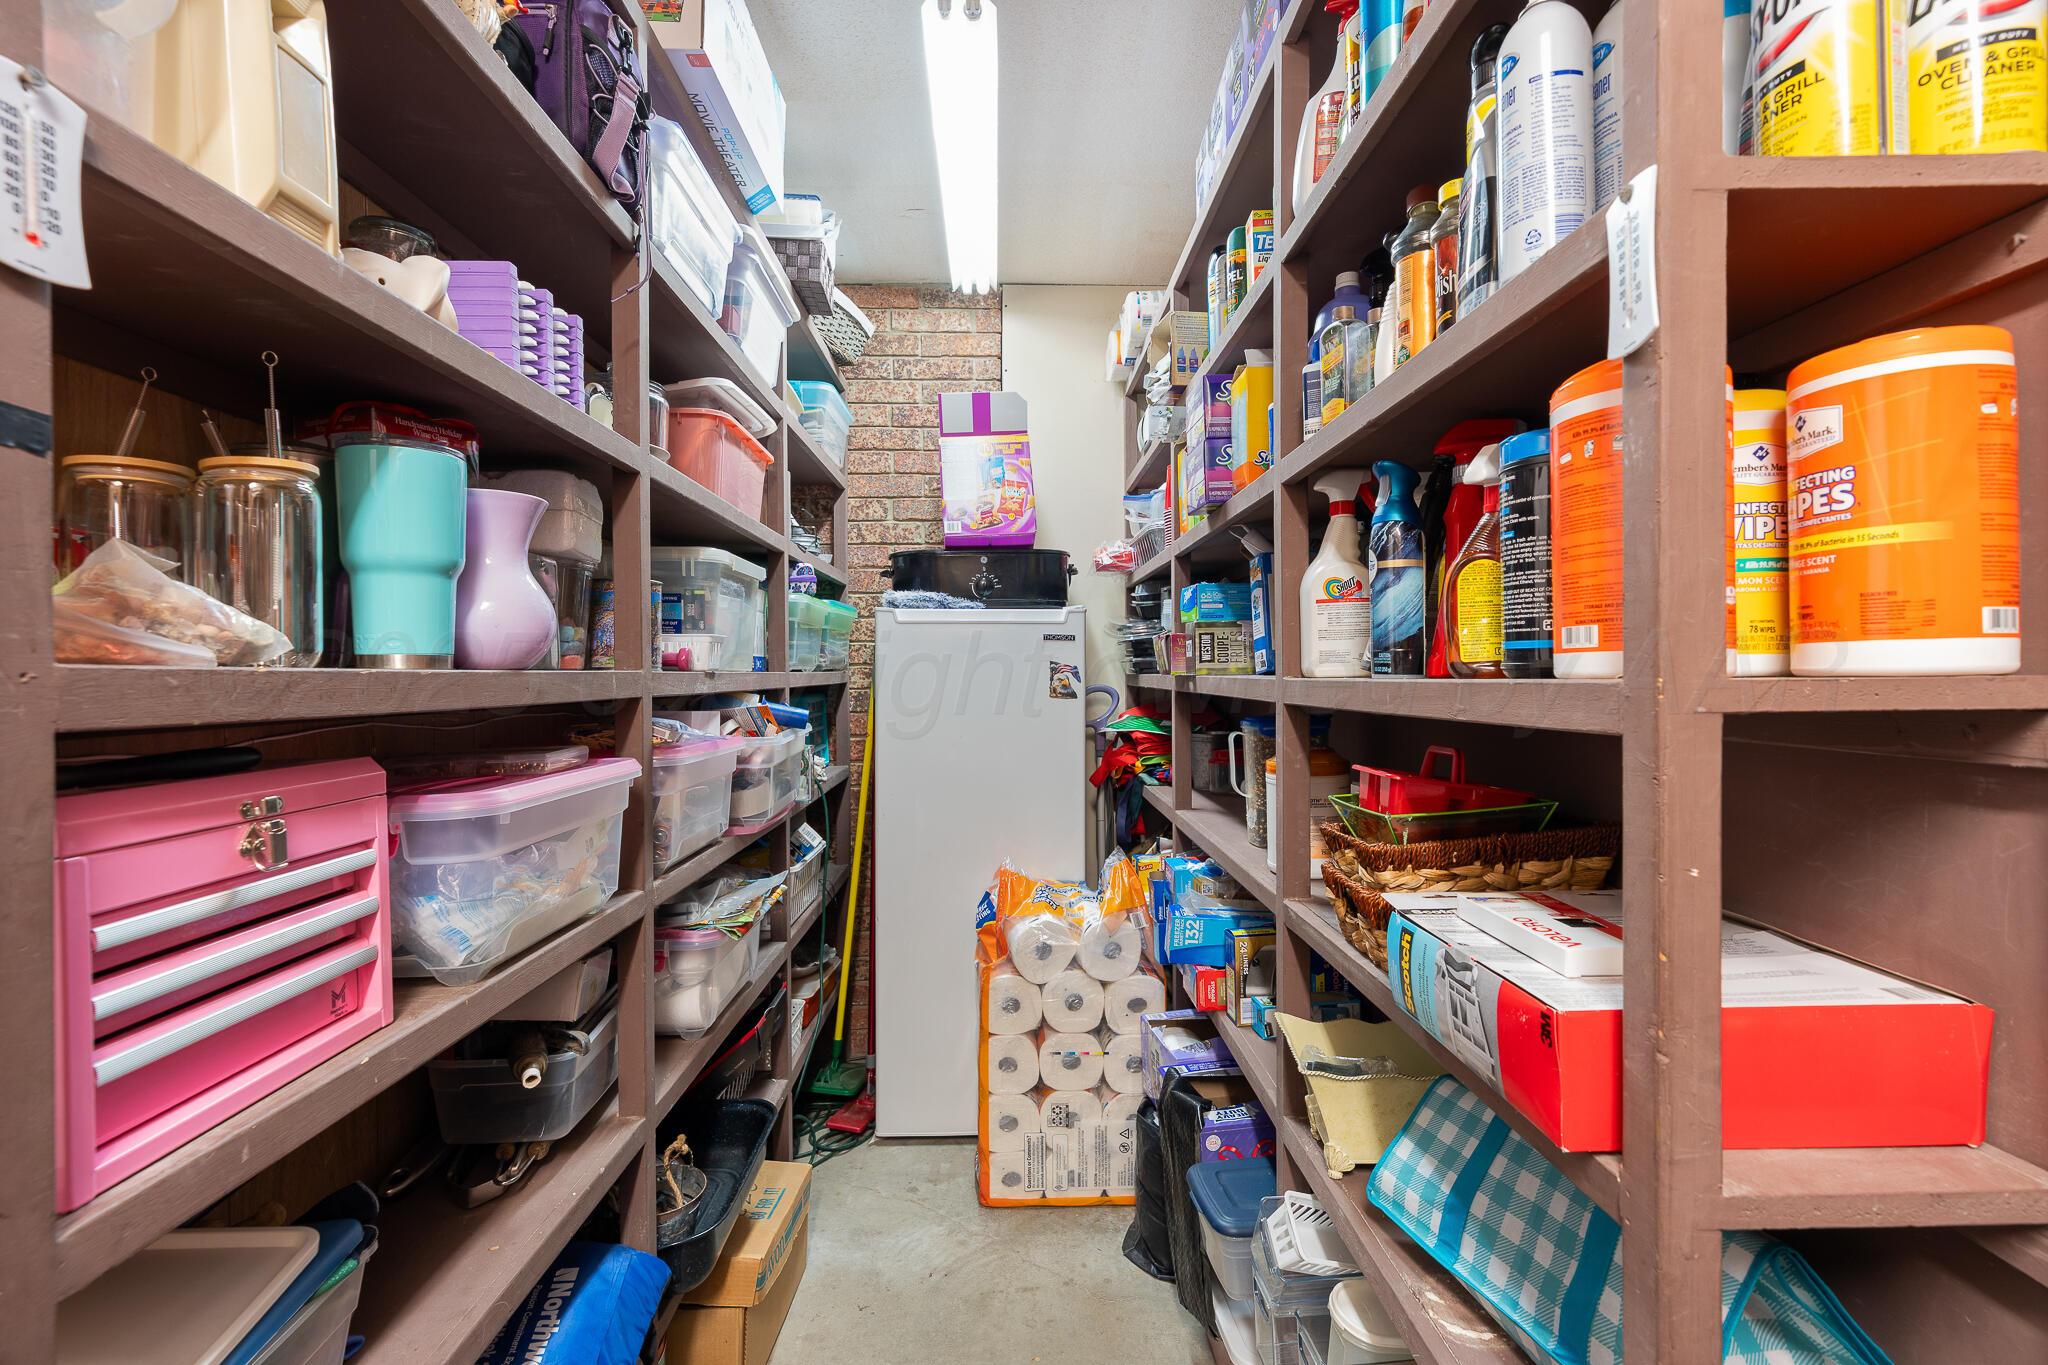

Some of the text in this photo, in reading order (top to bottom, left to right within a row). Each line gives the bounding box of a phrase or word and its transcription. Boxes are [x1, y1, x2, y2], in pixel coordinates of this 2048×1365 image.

[1773, 73, 1826, 104] GRILL
[1941, 60, 2036, 90] CLANER
[1760, 93, 1803, 128] ANER
[688, 92, 719, 134] MOVIE
[713, 138, 747, 189] THEATER
[721, 127, 744, 161] POP-UP
[394, 416, 463, 440] Handpainted Holiday
[412, 429, 449, 443] Wine Glass
[1734, 463, 1769, 472] ember's
[1735, 502, 1787, 516] INFECTI
[1793, 483, 1856, 520] IPES
[1734, 515, 1788, 541] IPE
[1867, 531, 1899, 541] Seconds
[1807, 554, 1837, 566] SCENT
[1336, 576, 1356, 594] SHOUT
[1201, 634, 1212, 661] WESTON
[1217, 631, 1229, 664] COUPE-
[1230, 631, 1243, 663] FRITES
[1185, 920, 1199, 945] 132
[1239, 941, 1248, 953] 24
[1513, 916, 1583, 948] VELCRO
[1401, 932, 1416, 1014] Scotch
[1540, 1011, 1554, 1049] 3M
[767, 1236, 785, 1277] AVON
